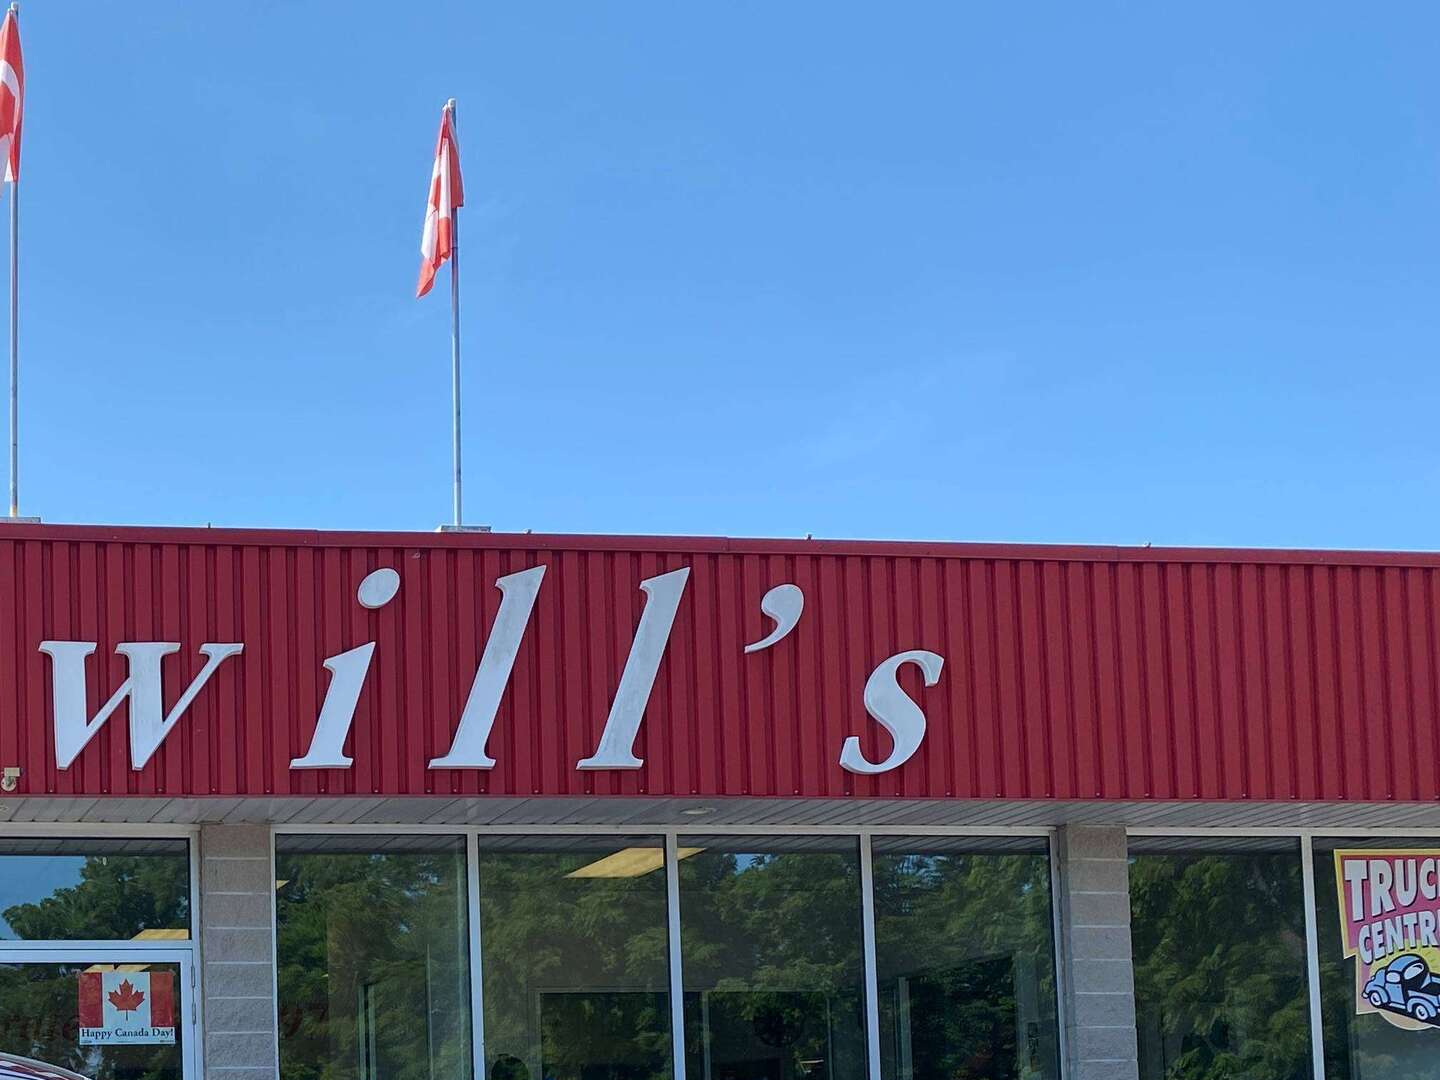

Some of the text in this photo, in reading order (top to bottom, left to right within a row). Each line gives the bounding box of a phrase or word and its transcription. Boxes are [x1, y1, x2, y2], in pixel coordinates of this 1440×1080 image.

[1344, 858, 1440, 922] TRUC
[1358, 909, 1440, 965] CENTR
[81, 1028, 174, 1039] Happy Canada Day!
